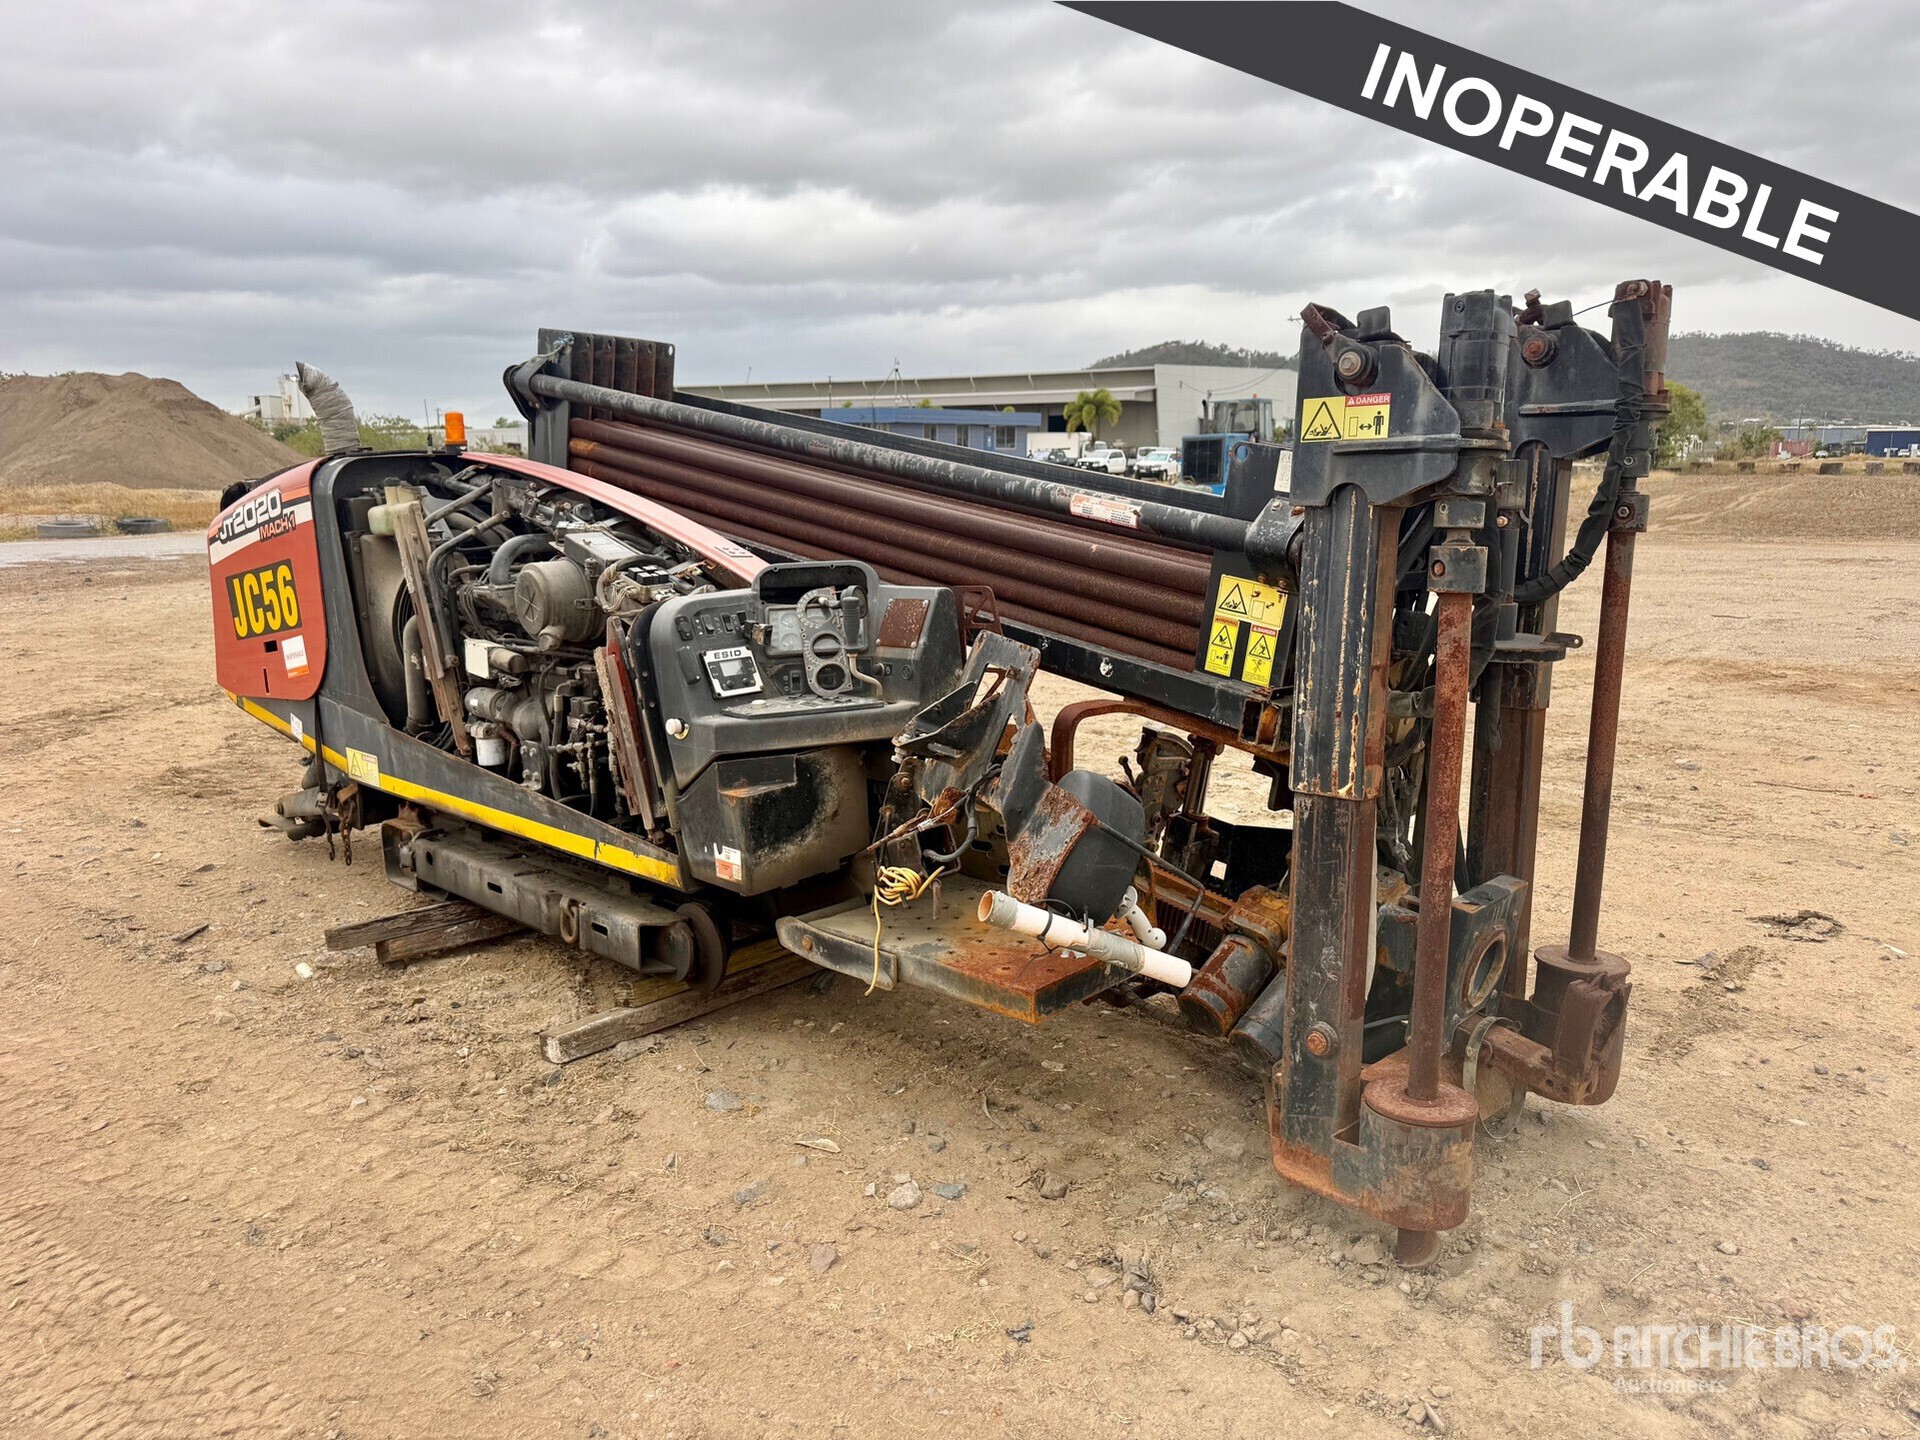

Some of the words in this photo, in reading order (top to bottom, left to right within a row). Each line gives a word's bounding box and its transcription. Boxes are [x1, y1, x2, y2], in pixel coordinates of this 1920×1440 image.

[1355, 395, 1390, 405] DANGER
[219, 489, 282, 540] JT2020
[233, 564, 299, 638] JC56
[714, 649, 742, 660] ESID
